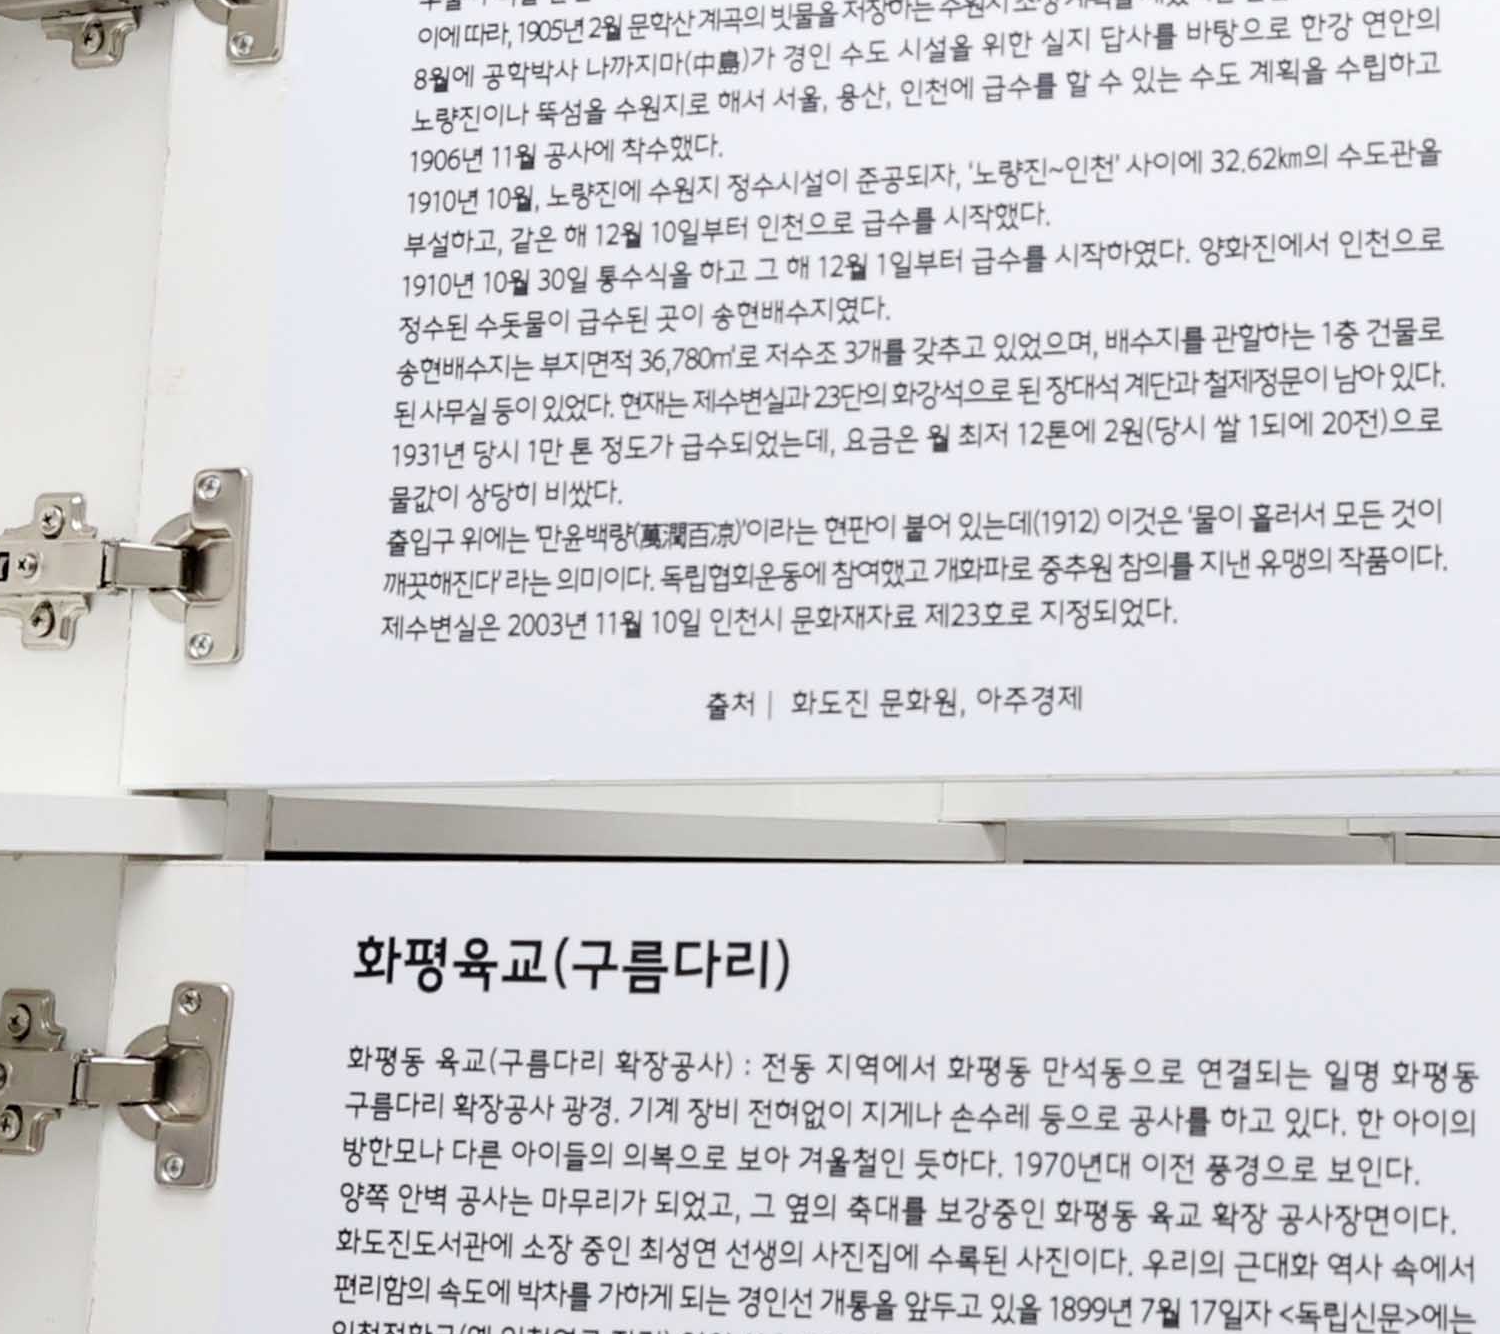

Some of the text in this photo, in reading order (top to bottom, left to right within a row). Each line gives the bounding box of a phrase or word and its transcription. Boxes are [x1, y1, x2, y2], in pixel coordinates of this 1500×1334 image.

[411, 51, 1441, 135] 노량진이나 뚝섬을 수원지로 해서 서울, 용산, 인천에 급수를 할 수 있는 수도 계획을 수립하고
[410, 133, 723, 174] 1906년 11월 공사에 착수했다.
[403, 201, 1051, 259] 부설하고, 같은 해 12월 10일부터 인천으로 급수를 시작했다.
[398, 295, 891, 345] 정수된 수돗물이 급수된 곳이 송현배수지였다.
[388, 479, 622, 515] 물값이 상당히 비쌌다.
[380, 597, 1178, 644] 제수변실은 2003년 11월 10일 인천시 문화재자료 제23호로 지정되었다.
[706, 685, 1082, 721] 출처 화도진 문화원, 아주경제
[352, 934, 790, 995] 화평육교(구름다리)
[344, 1091, 1476, 1140] 구름다리 확장공사 광경. 기계 장비 전혀없이 지게나 손수레 등으로 공사를 하고 있다. 한 아이의
[342, 1135, 1420, 1188] 방한모나 다른 아이들의 의복으로 보아 겨울철인 듯하다. 1970년대 이전 풍경으로 보인다.
